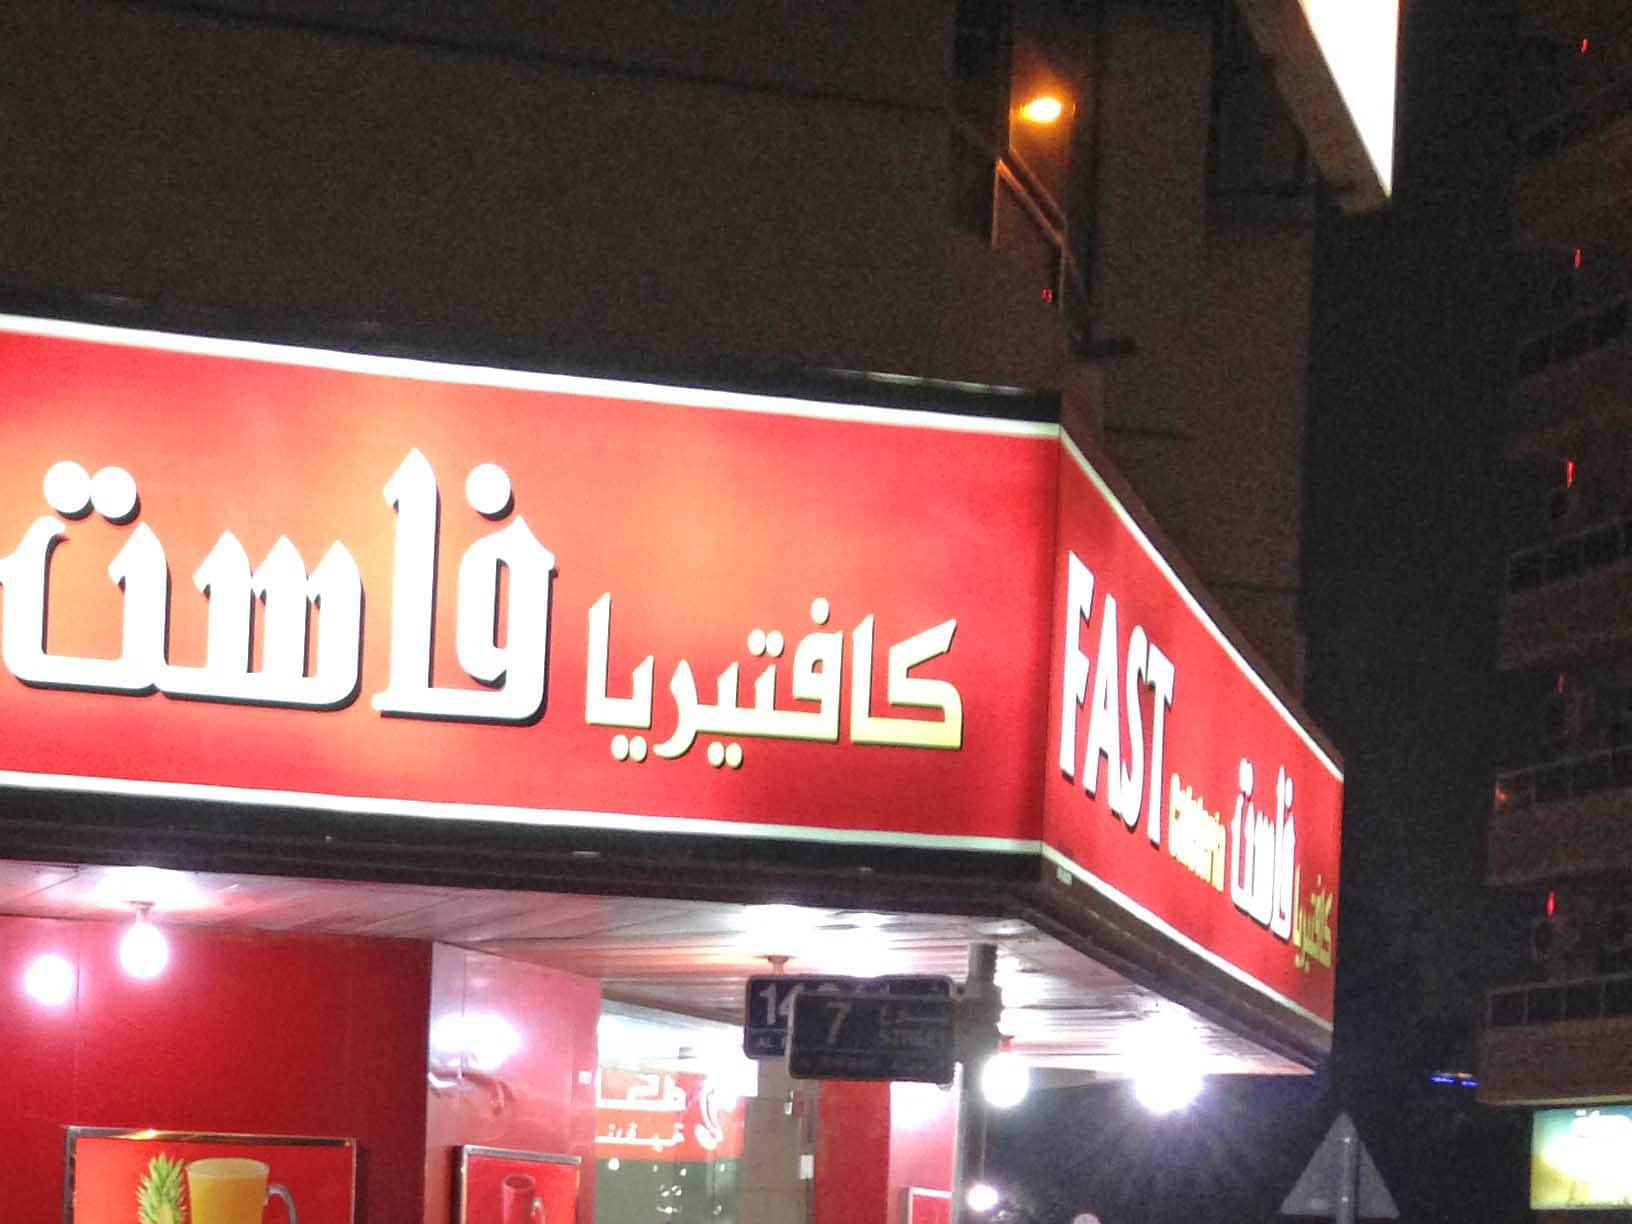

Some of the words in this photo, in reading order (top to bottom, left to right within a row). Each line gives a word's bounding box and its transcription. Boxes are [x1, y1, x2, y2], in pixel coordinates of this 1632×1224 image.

[584, 590, 964, 767] كافتيريا
[1058, 550, 1175, 848] FAST
[1230, 758, 1296, 944] فاست
